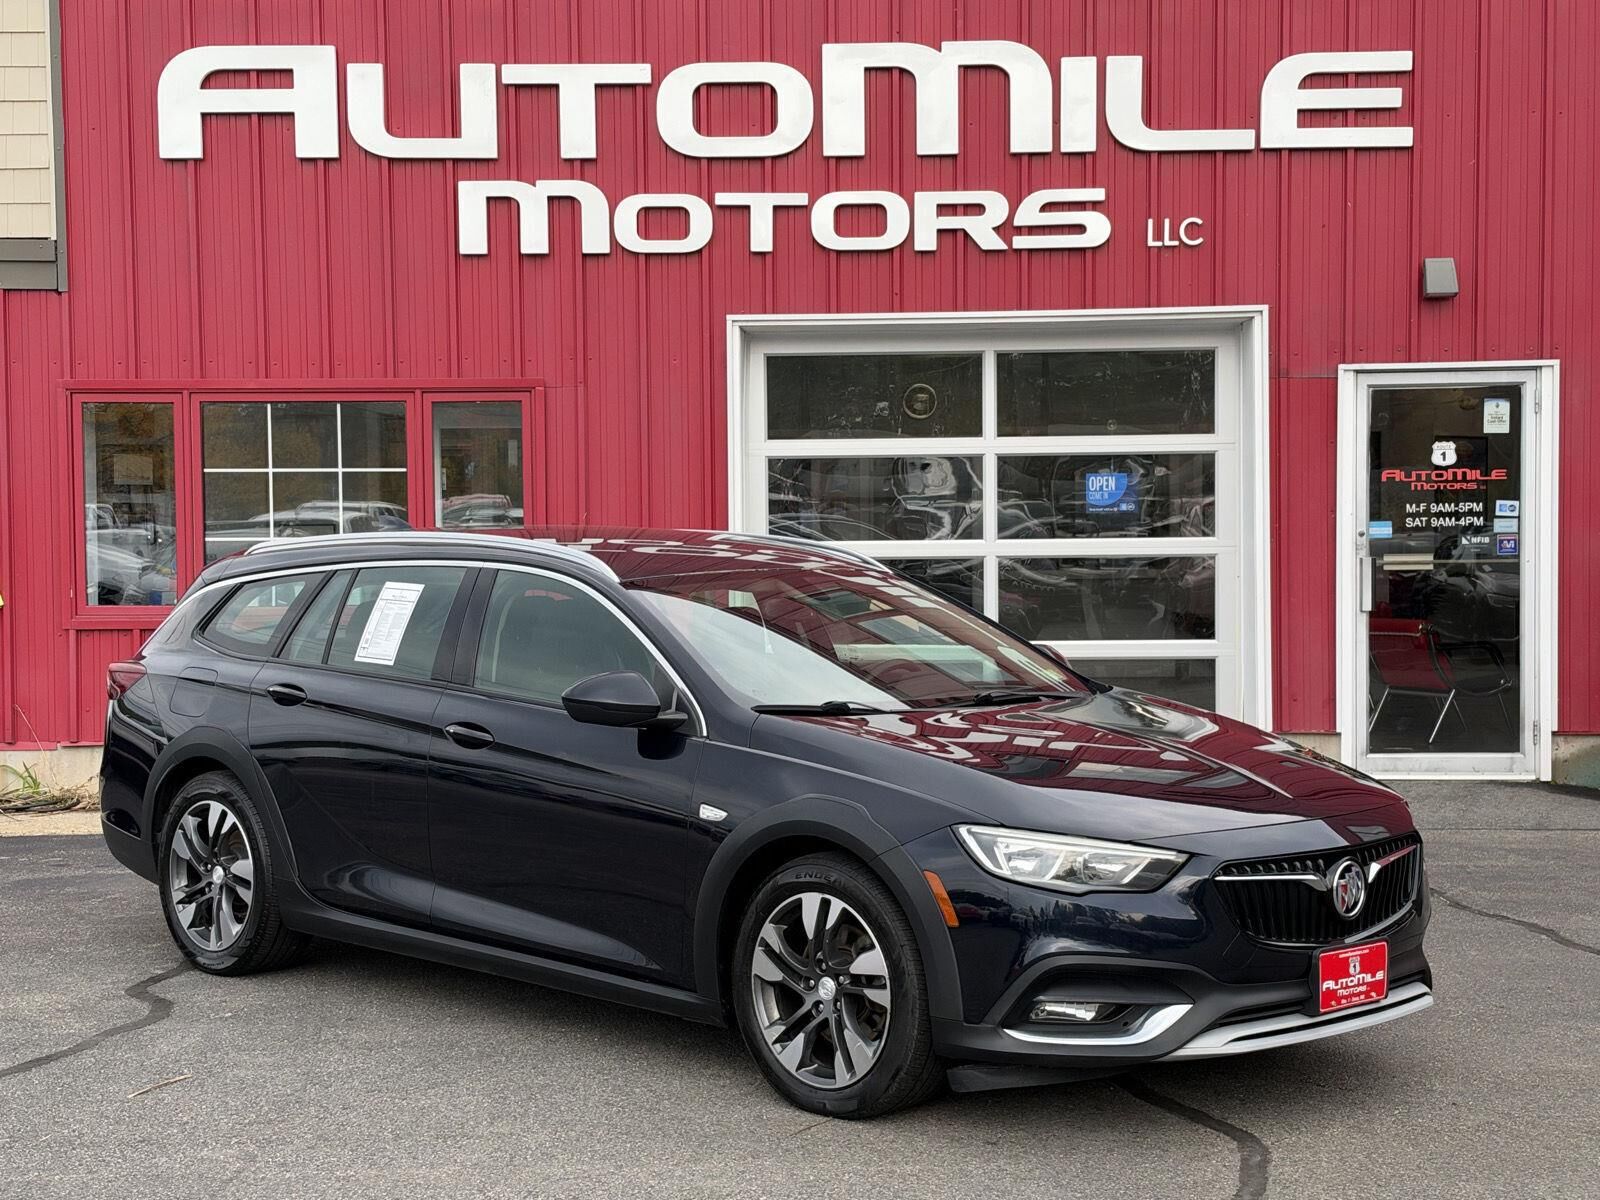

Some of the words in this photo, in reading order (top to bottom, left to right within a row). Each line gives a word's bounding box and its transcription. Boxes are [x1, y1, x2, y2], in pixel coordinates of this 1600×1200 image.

[157, 39, 1414, 160] AUTOMILE
[457, 179, 1112, 256] MOTORS
[1147, 217, 1204, 248] LLC
[1440, 451, 1446, 462] 1
[1381, 468, 1507, 482] AUTOMILE
[1088, 476, 1116, 491] OPEN
[1411, 482, 1478, 491] MOTORS
[1406, 503, 1427, 513] M-F
[1430, 502, 1483, 513] 9AM-5PM
[1405, 517, 1428, 527] SAT
[1430, 516, 1484, 527] 9AM-4PM
[1352, 963, 1357, 972] 1
[1323, 971, 1384, 991] AUTOMILE
[1337, 985, 1366, 996] MOTORS
